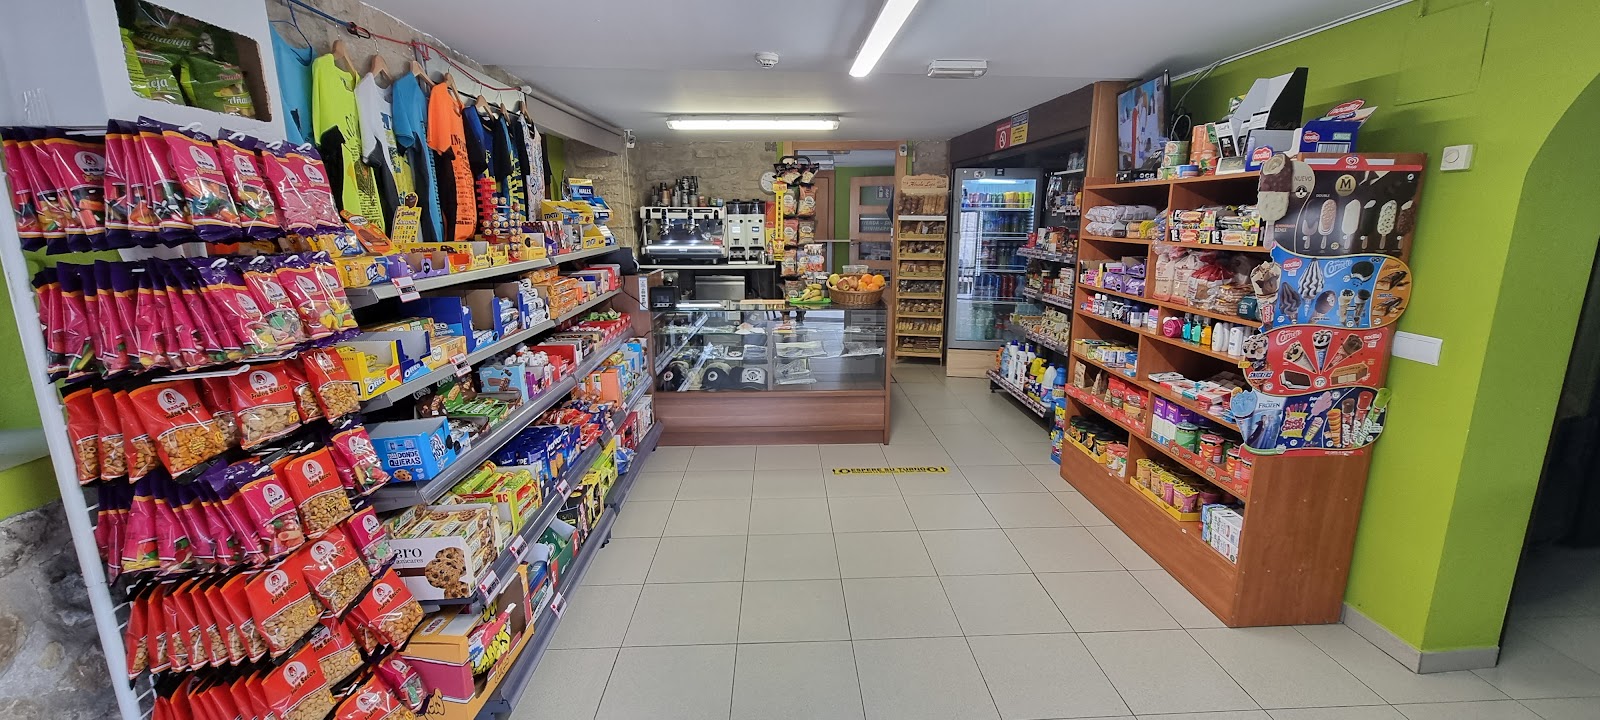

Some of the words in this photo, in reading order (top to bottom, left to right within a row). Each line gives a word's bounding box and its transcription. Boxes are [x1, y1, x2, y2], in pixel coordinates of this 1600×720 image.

[1253, 151, 1272, 160] nocilla
[1339, 179, 1351, 189] M
[335, 237, 349, 250] TUC
[1283, 261, 1301, 269] nocilla
[1323, 259, 1353, 278] Cornetto
[366, 265, 378, 280] TUC
[435, 323, 448, 331] EO
[504, 320, 518, 336] OREO
[476, 331, 492, 347] OREO
[405, 363, 421, 378] OREO
[1249, 371, 1273, 379] SNICKERS
[269, 384, 288, 395] Secos
[367, 377, 386, 395] OREO
[1355, 417, 1373, 447] Calippo
[398, 450, 419, 459] DONDE
[389, 456, 421, 468] QUIERAS
[282, 580, 298, 592] Secos
[300, 669, 317, 684] Secos
